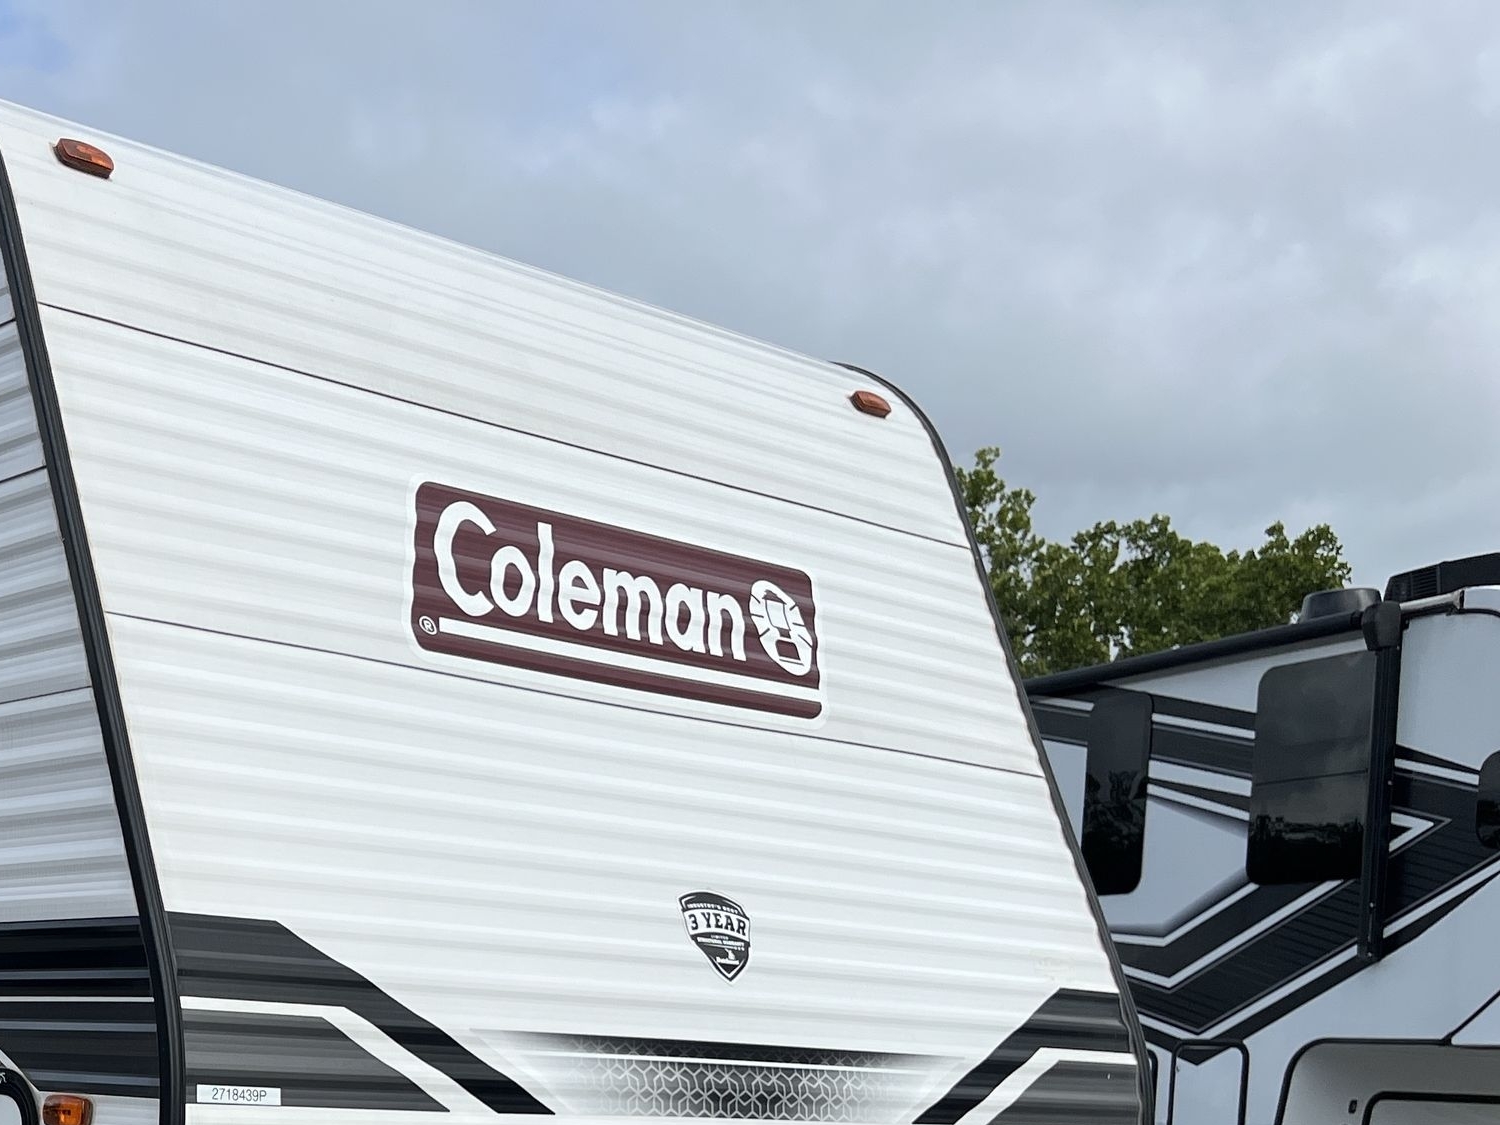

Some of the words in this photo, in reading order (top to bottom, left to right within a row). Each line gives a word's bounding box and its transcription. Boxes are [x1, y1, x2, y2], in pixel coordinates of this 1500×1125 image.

[433, 500, 747, 662] Coleman
[688, 914, 698, 930] 3
[701, 912, 746, 936] YEAR
[211, 1086, 267, 1102] 2718439P
